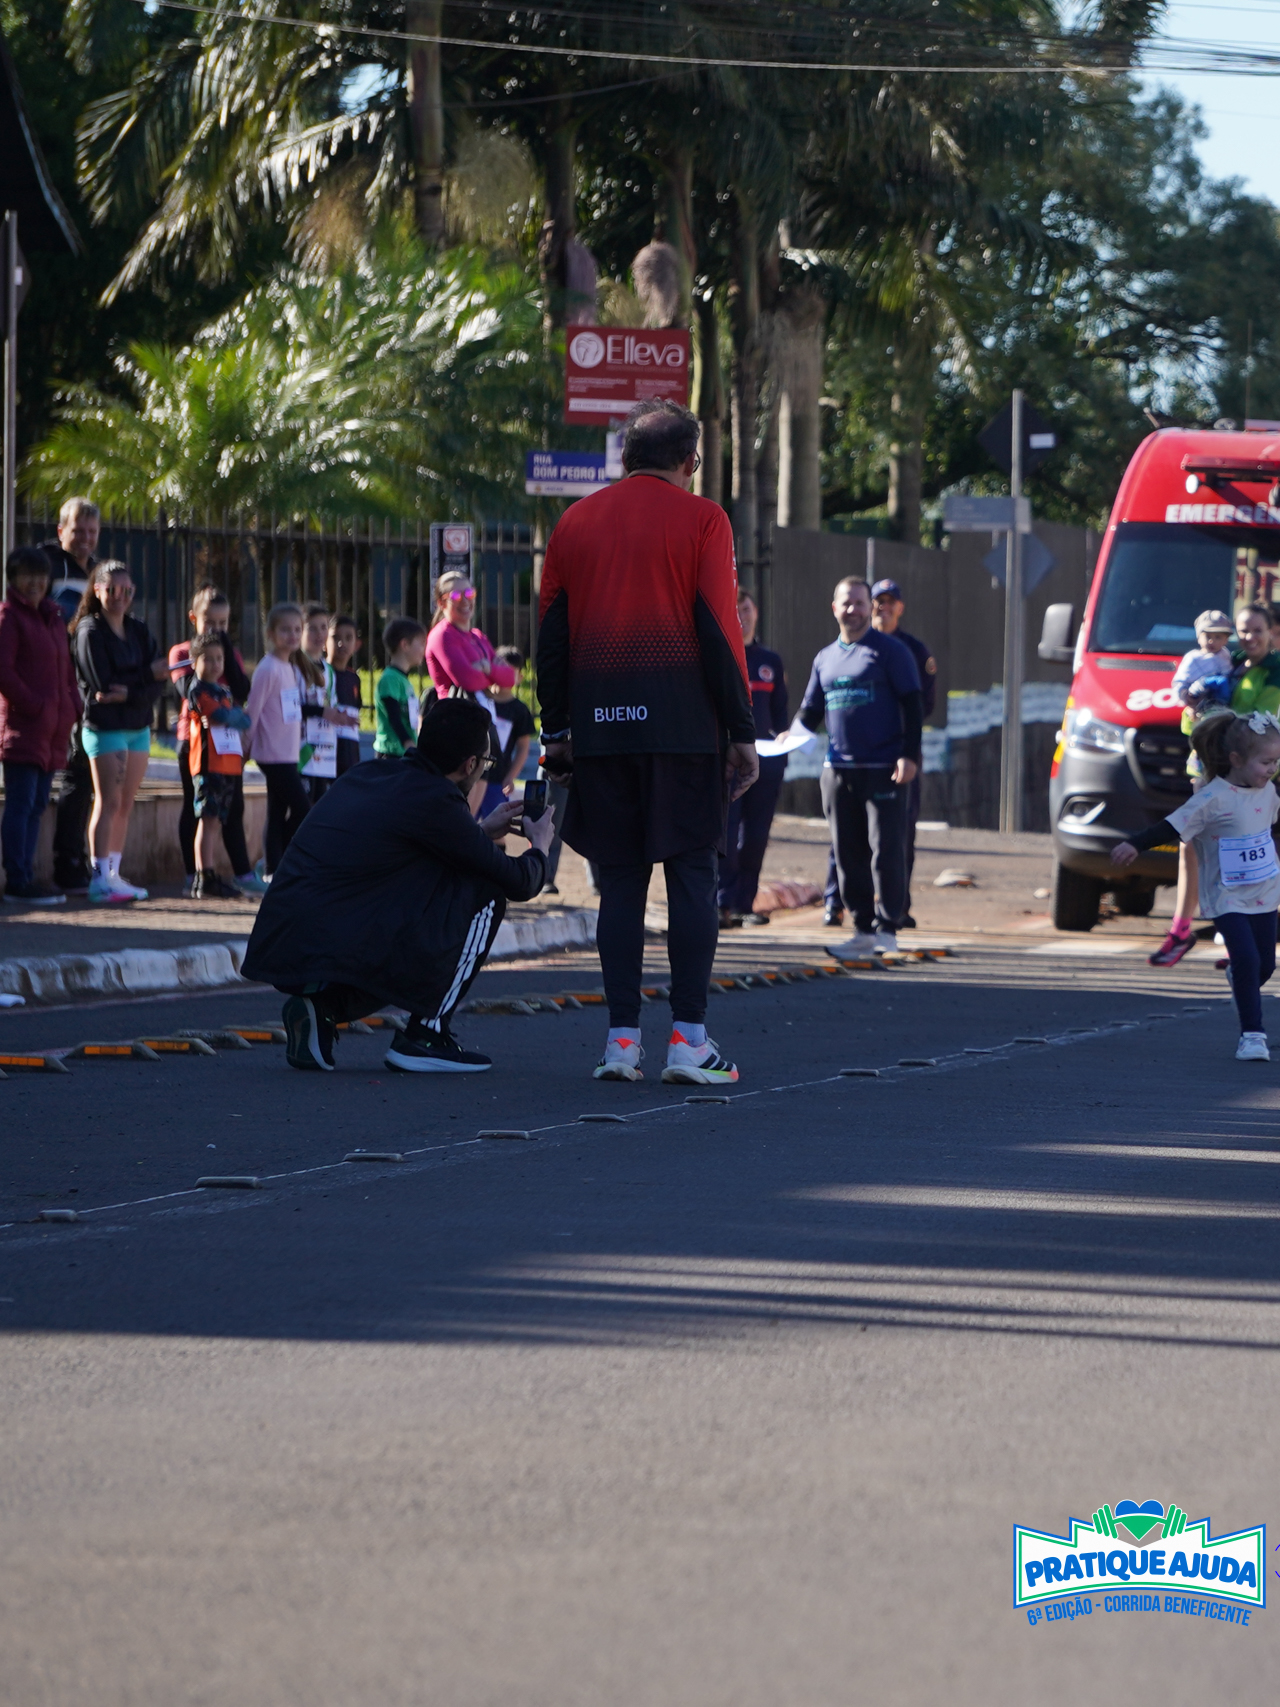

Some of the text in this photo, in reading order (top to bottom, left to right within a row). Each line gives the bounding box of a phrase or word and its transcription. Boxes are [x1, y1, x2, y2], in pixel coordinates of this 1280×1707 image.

[606, 334, 685, 367] Elleva
[533, 454, 553, 465] RUA
[533, 466, 558, 479] DOM
[560, 467, 596, 480] PEDRO
[594, 705, 648, 723] BUENO
[1239, 847, 1266, 862] 183
